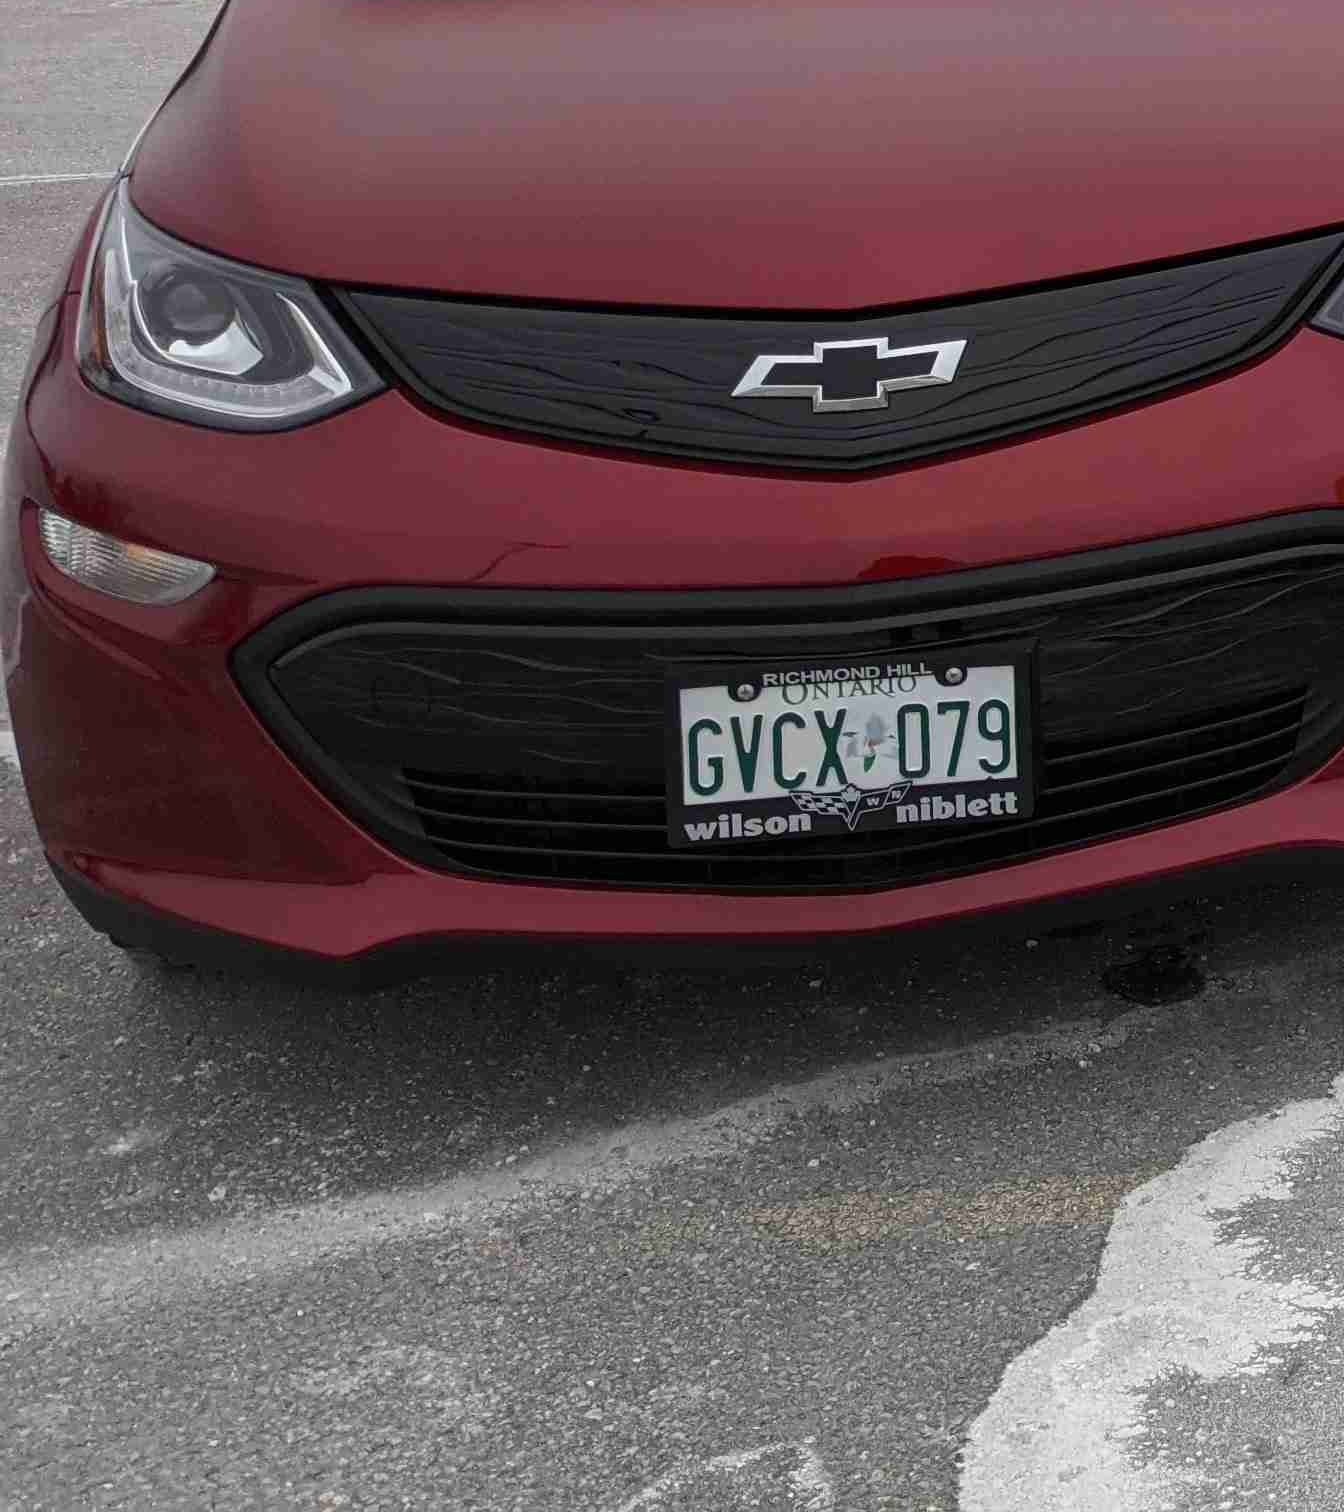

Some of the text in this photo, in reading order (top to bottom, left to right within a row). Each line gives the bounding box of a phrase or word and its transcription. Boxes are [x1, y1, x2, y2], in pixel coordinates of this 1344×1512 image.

[762, 663, 933, 686] RICHMOND HILL
[782, 675, 916, 705] ONTARIO
[688, 699, 1010, 796] GVCX 079
[684, 792, 1018, 841] wilson niblett
